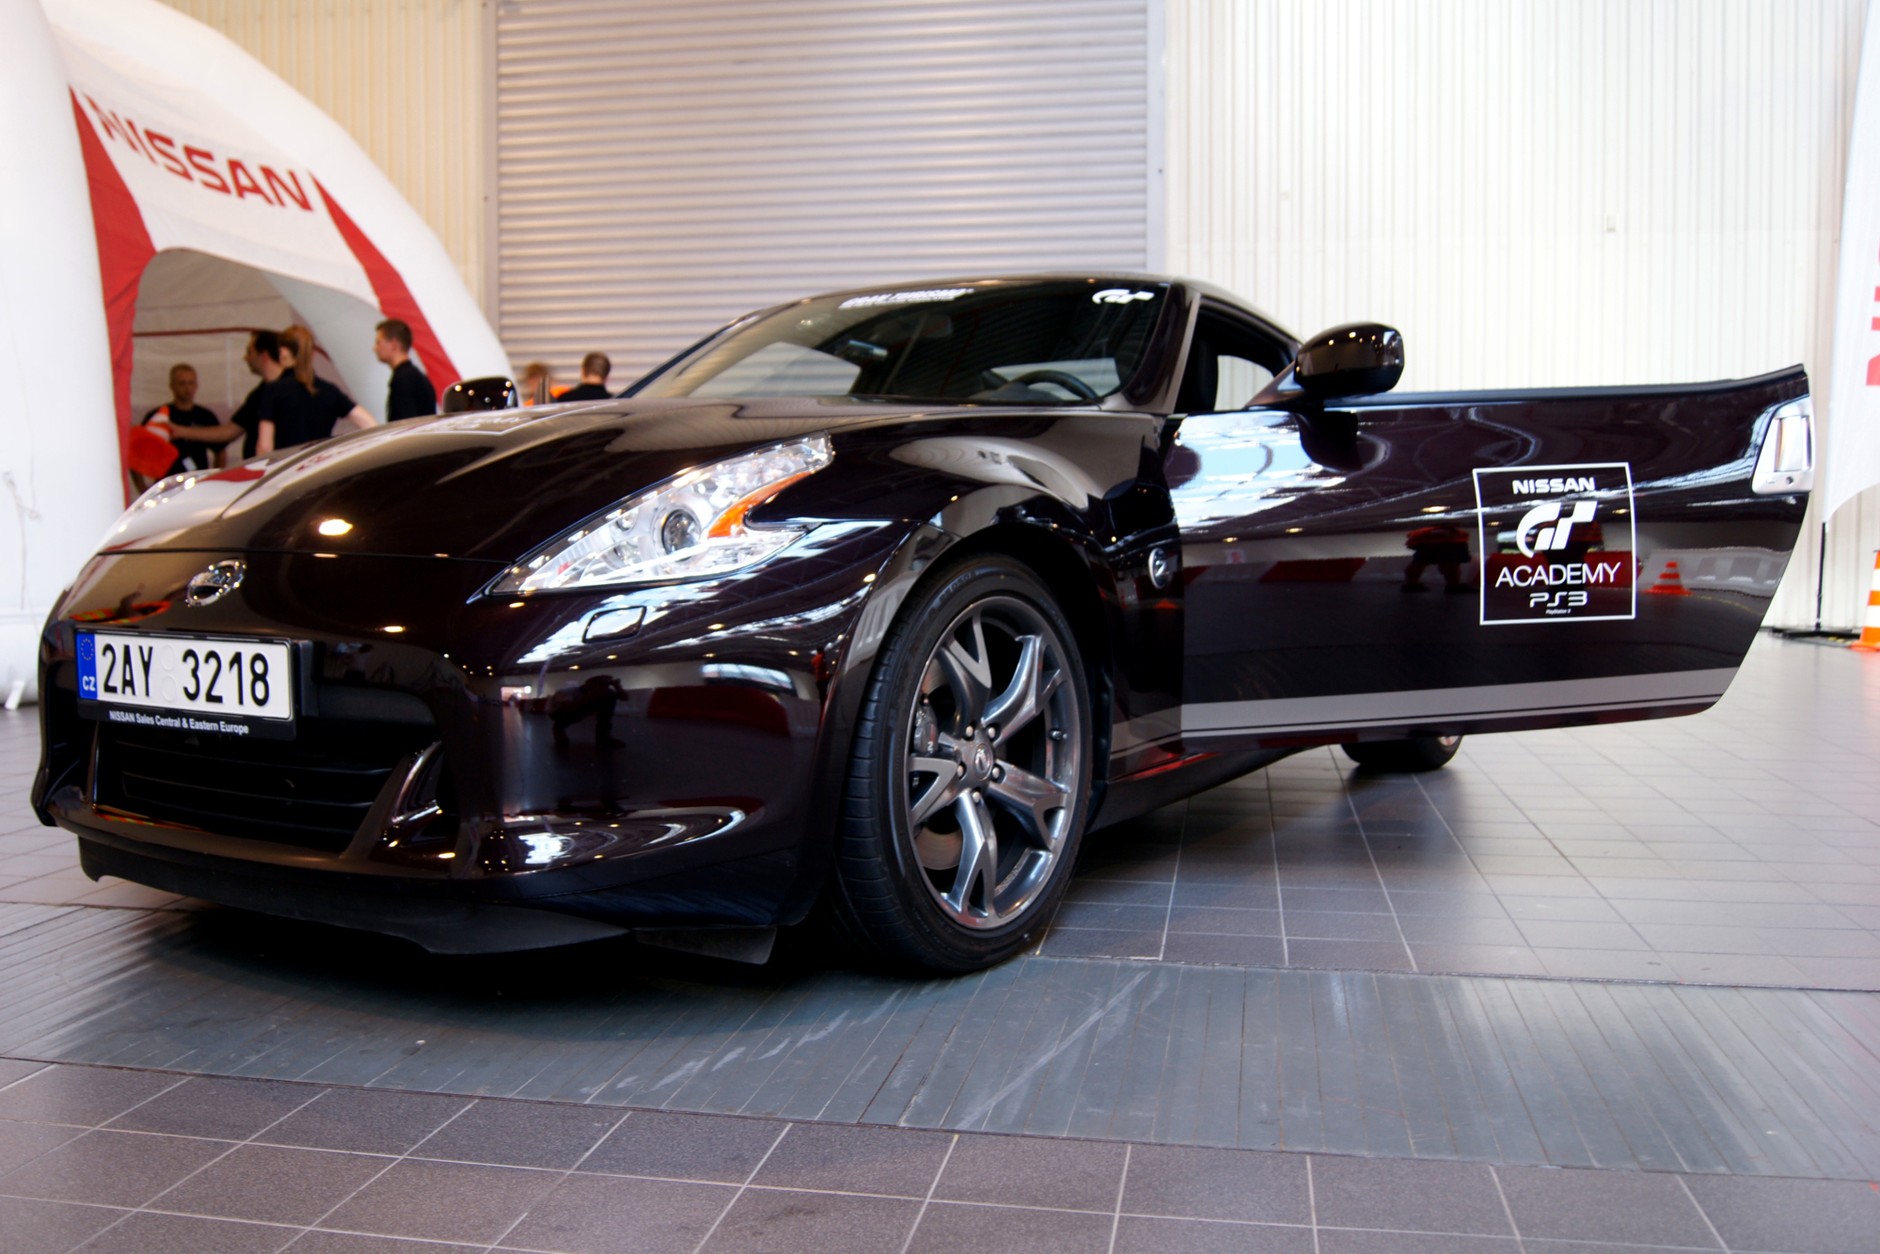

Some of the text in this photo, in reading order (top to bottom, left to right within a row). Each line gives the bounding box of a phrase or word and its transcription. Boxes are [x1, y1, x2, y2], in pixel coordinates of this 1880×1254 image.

[82, 91, 314, 212] NISSAN
[1512, 477, 1595, 494] NISSAN
[1494, 561, 1622, 588] ACADEMY
[1529, 590, 1588, 608] PS3
[81, 675, 96, 692] CZ
[101, 643, 270, 707] 2AY 3218
[109, 710, 249, 736] NISSAN Sales Central & Eastern Europe
